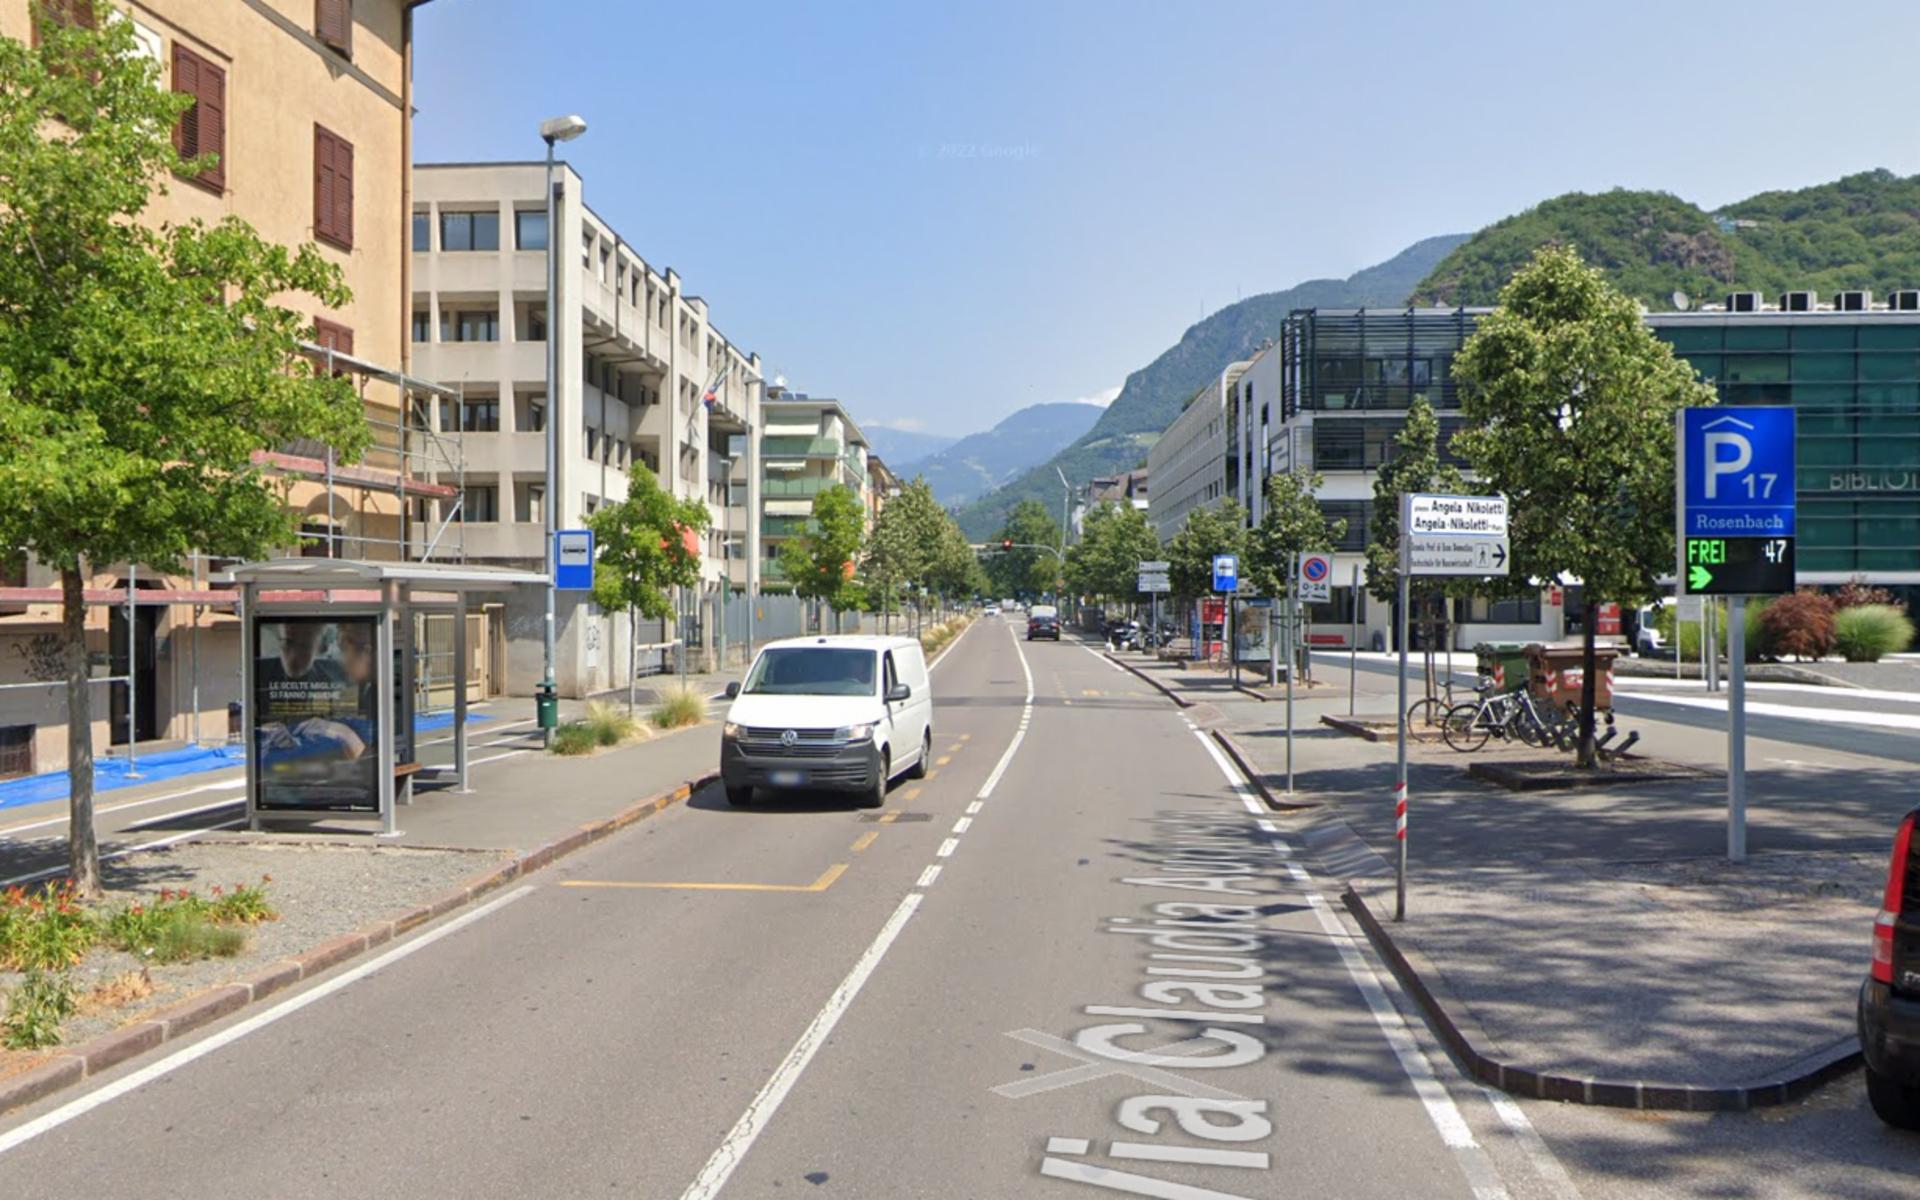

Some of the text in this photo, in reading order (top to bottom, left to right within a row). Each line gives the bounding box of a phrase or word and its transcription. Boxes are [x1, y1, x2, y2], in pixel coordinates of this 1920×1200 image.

[1704, 432, 1778, 499] P 17
[1431, 500, 1463, 516] Angela
[1696, 514, 1785, 529] Rosenbach
[1688, 539, 1788, 563] FREI 47
